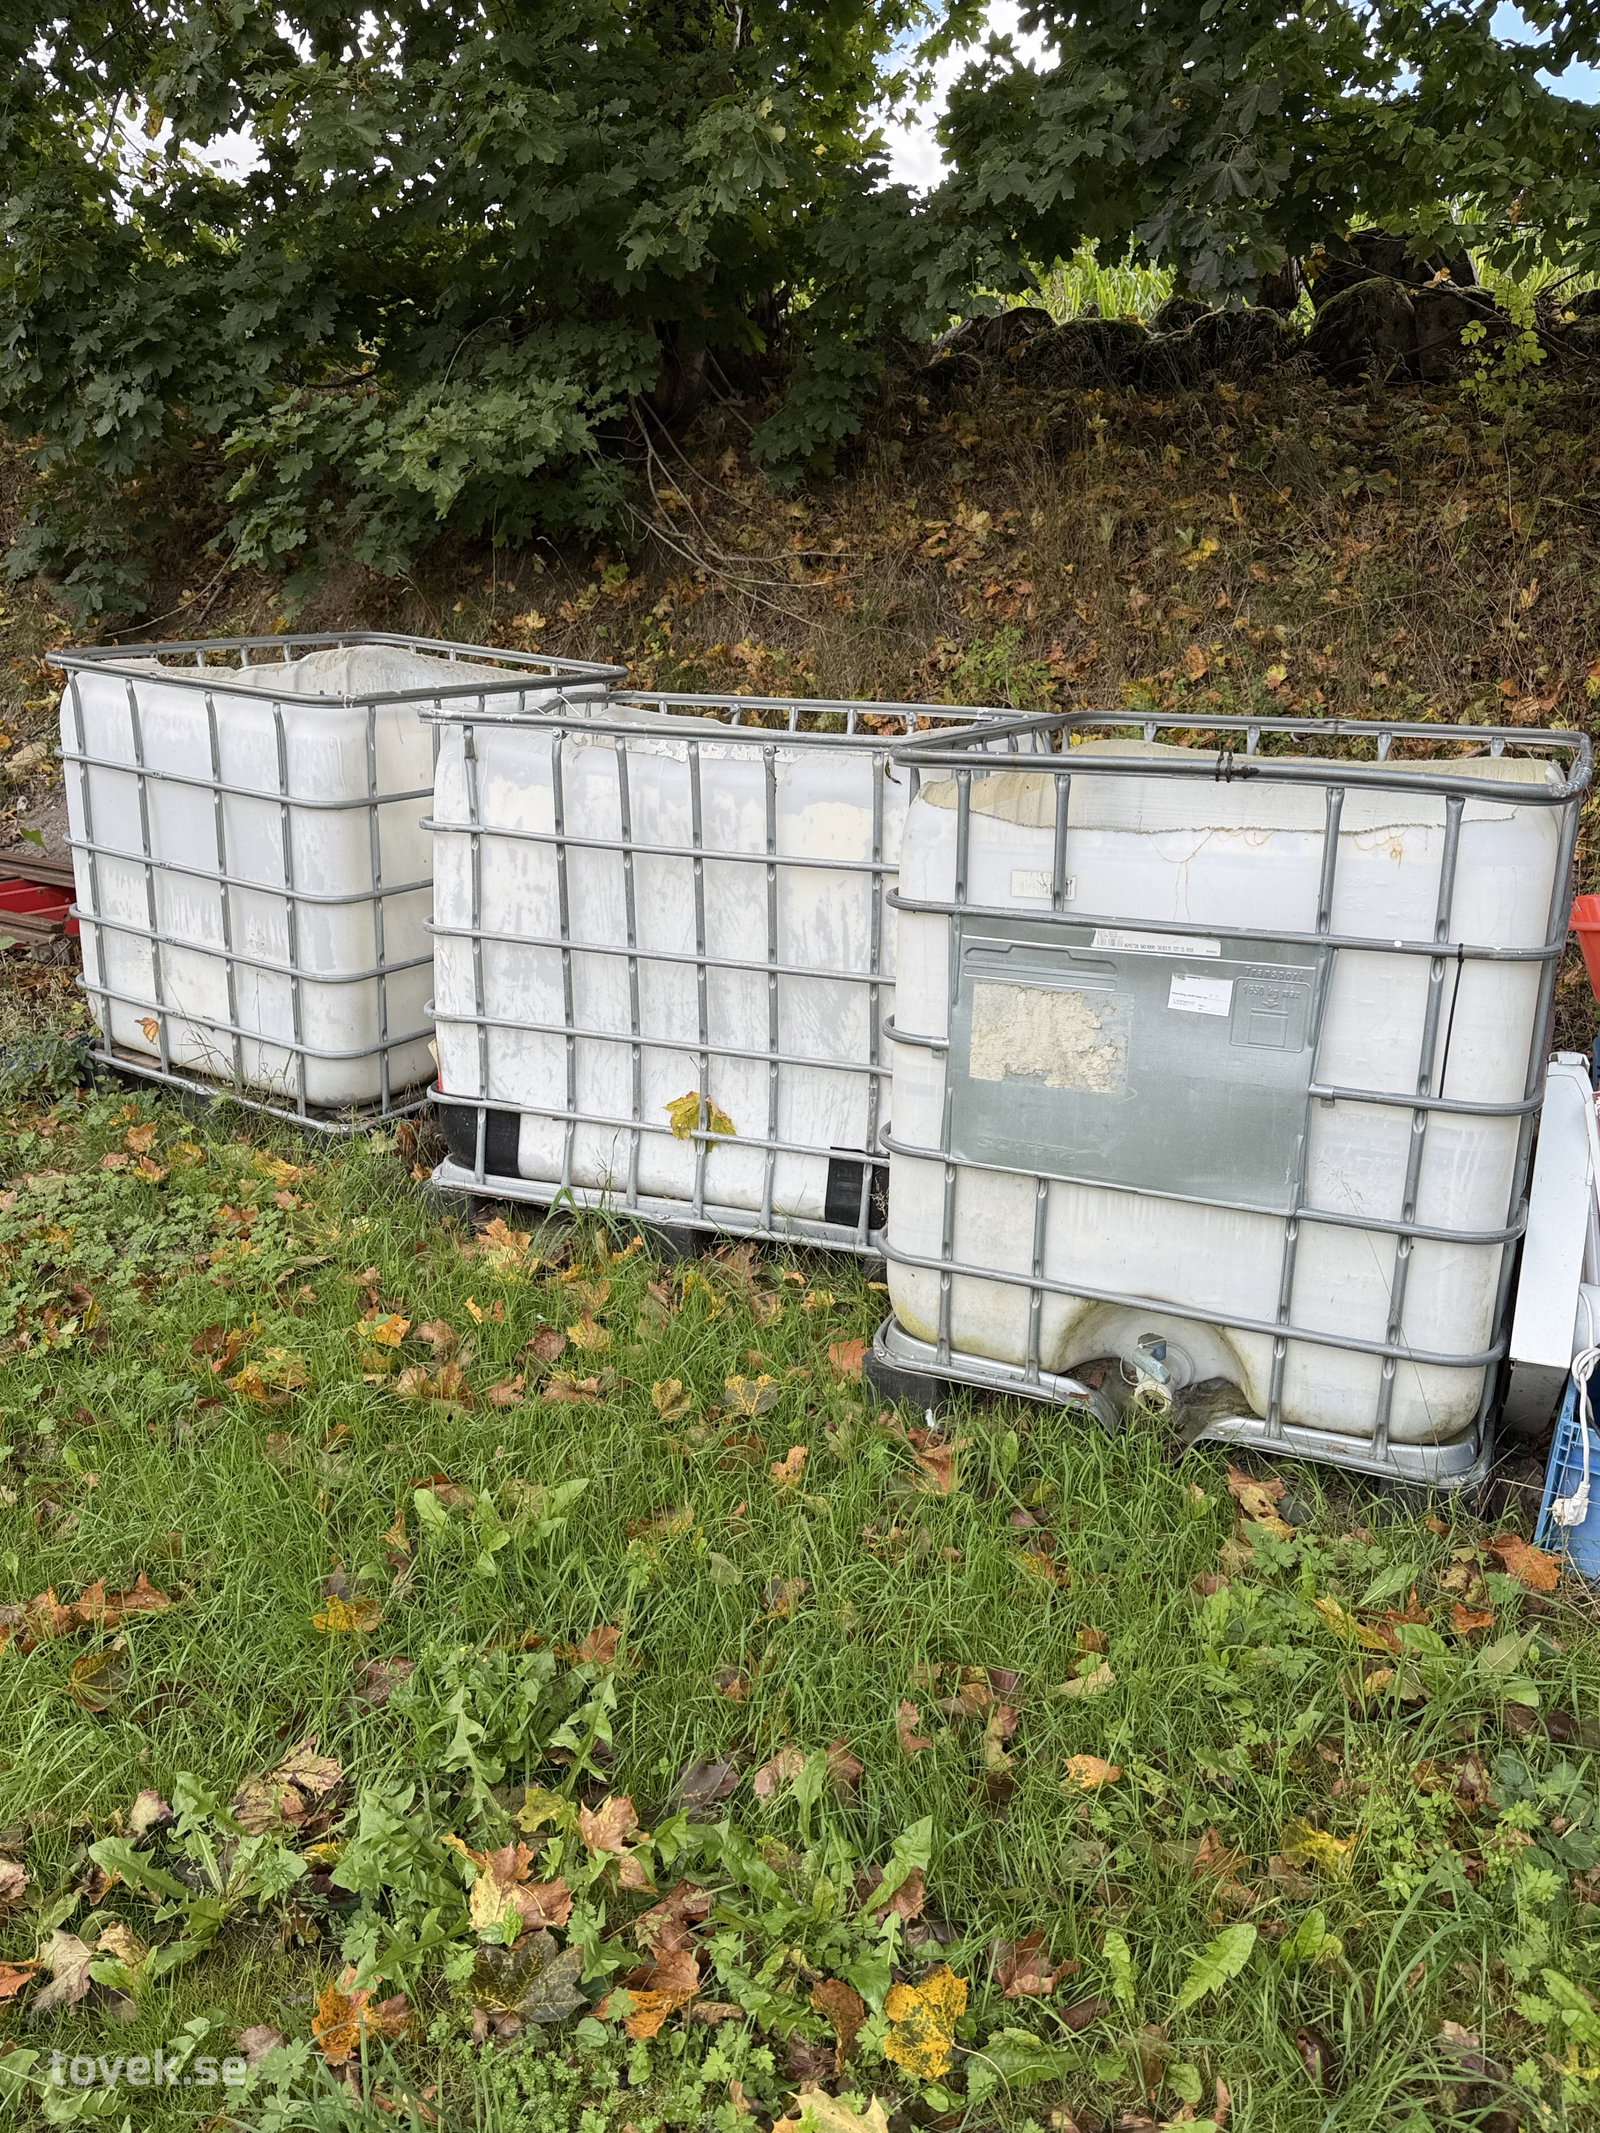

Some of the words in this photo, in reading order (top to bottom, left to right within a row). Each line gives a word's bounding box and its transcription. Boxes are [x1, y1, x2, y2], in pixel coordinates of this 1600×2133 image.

[1244, 965, 1304, 982] Transport
[1243, 983, 1265, 996] 1650
[1267, 985, 1279, 999] kg
[1281, 989, 1301, 1000] max
